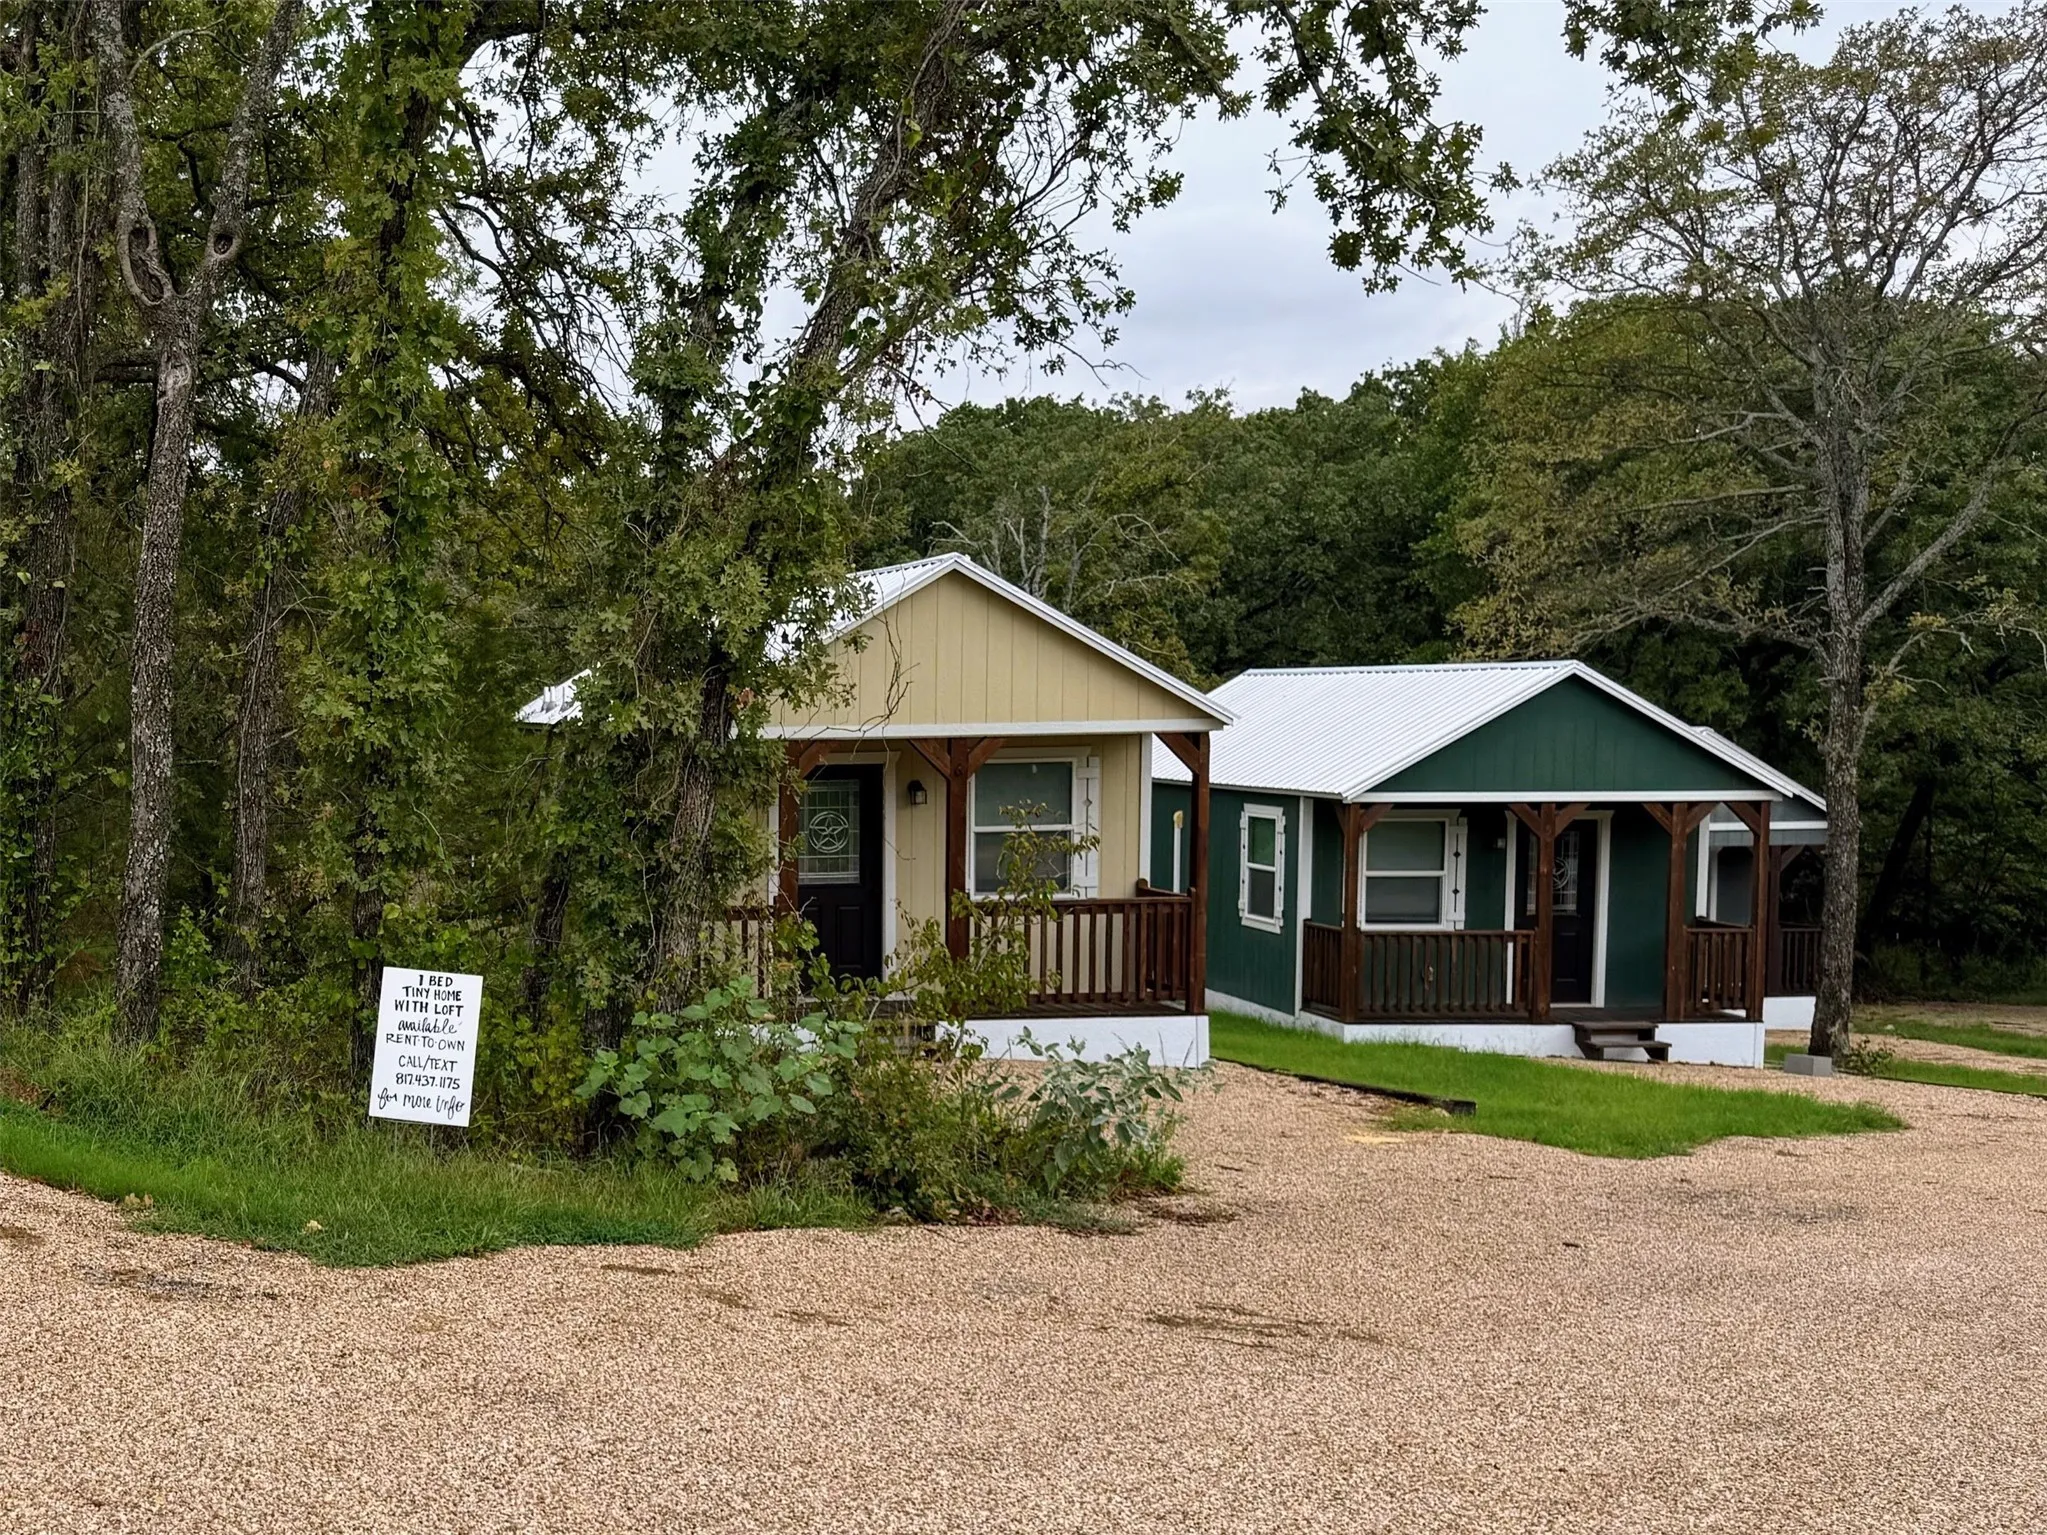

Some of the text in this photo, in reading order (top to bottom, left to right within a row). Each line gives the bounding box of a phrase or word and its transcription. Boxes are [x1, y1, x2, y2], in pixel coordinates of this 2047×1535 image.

[419, 975, 453, 987] 1 BED
[402, 986, 462, 1001] TINY HOME
[395, 999, 463, 1017] WITH LOFT
[398, 1018, 457, 1034] available
[399, 1055, 457, 1072] CALL/TEXT
[378, 1088, 397, 1109] for
[403, 1093, 431, 1108] more
